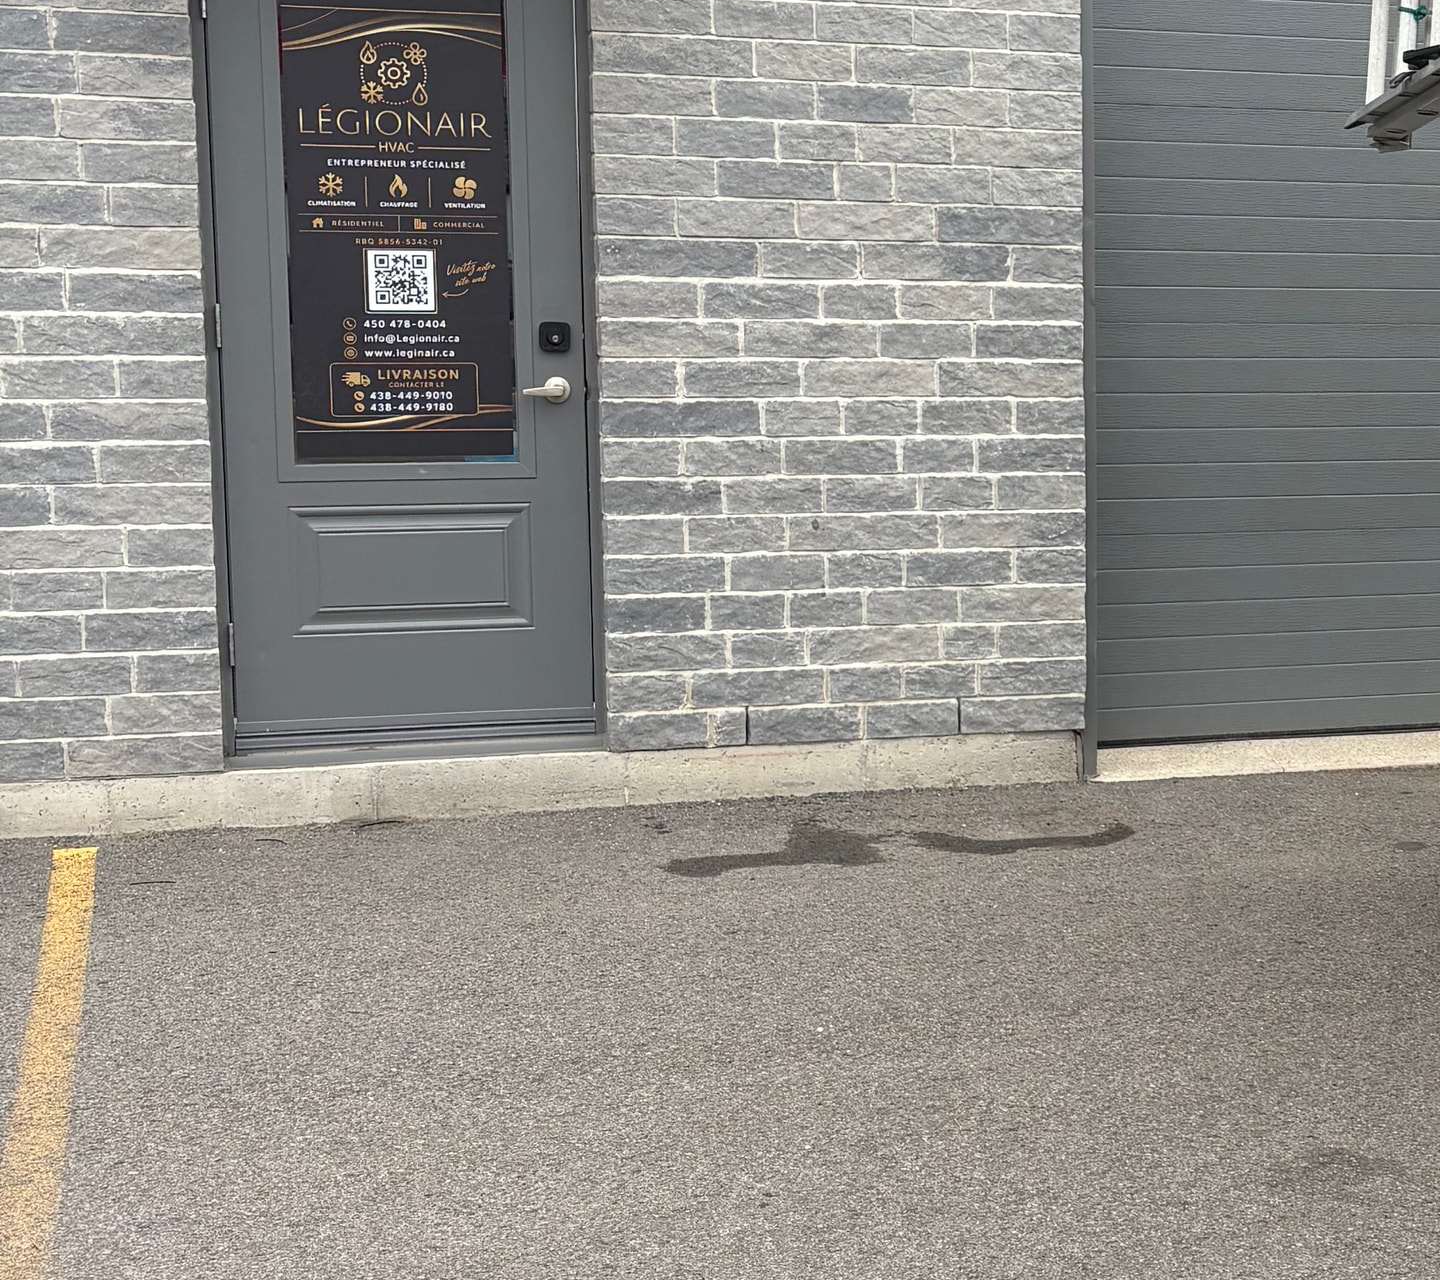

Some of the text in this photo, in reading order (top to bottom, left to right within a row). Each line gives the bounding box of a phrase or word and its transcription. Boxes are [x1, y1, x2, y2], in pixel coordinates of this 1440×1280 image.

[298, 103, 493, 139] LÉGIONAIR
[378, 141, 415, 153] HVAC
[327, 158, 466, 170] ENTREPRENEUR SPÉCIALISÉ
[307, 200, 356, 208] CLIMATISATION
[379, 201, 419, 209] CHAUFFAGE
[331, 219, 385, 228] RÉSIDENTIEL
[432, 221, 485, 229] COMMERCIAL
[355, 237, 375, 245] RBQ
[363, 319, 447, 329] 450 478-0404
[364, 333, 461, 345] info@Legionair.ca
[377, 369, 460, 381] LIVRAISON
[369, 390, 454, 400] 438-449-9010
[370, 402, 455, 412] 438-449-9180
